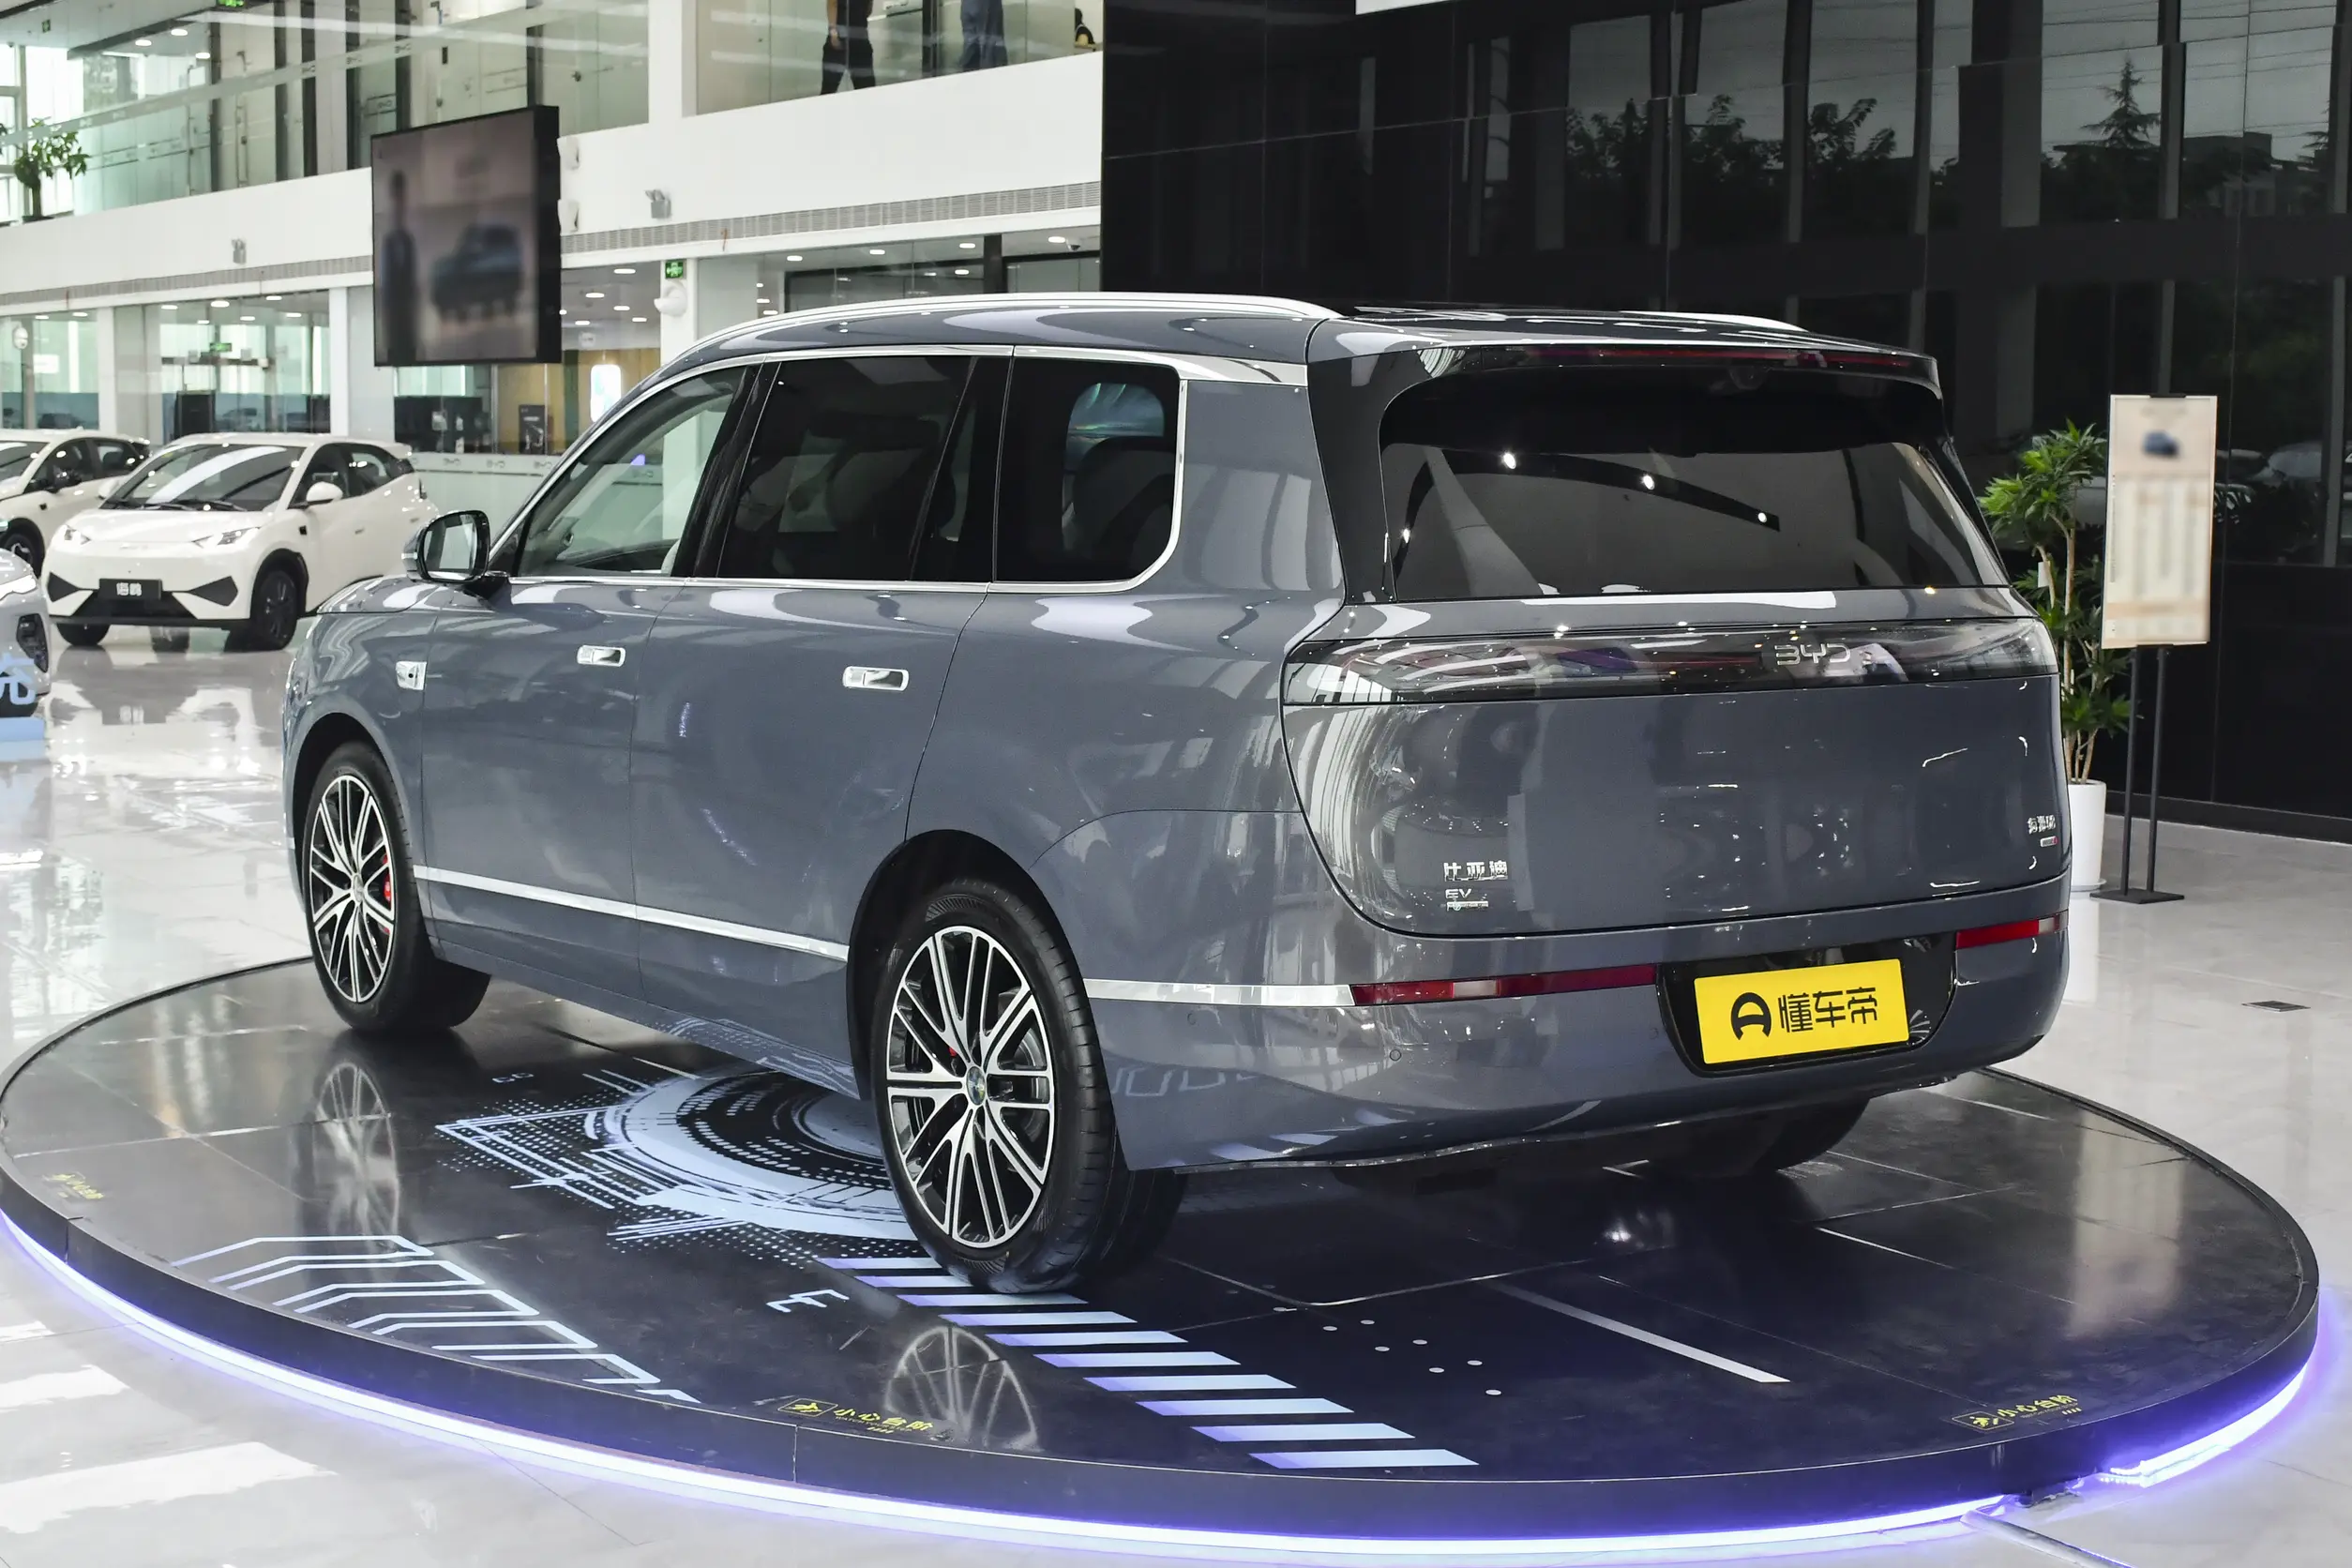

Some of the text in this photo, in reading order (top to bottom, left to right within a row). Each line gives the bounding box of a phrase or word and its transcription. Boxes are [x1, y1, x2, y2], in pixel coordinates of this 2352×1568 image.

[1774, 642, 1850, 666] BYD
[1443, 860, 1508, 882] 比亚迪
[1445, 888, 1472, 898] EV
[1778, 986, 1878, 1033] 懂车帝
